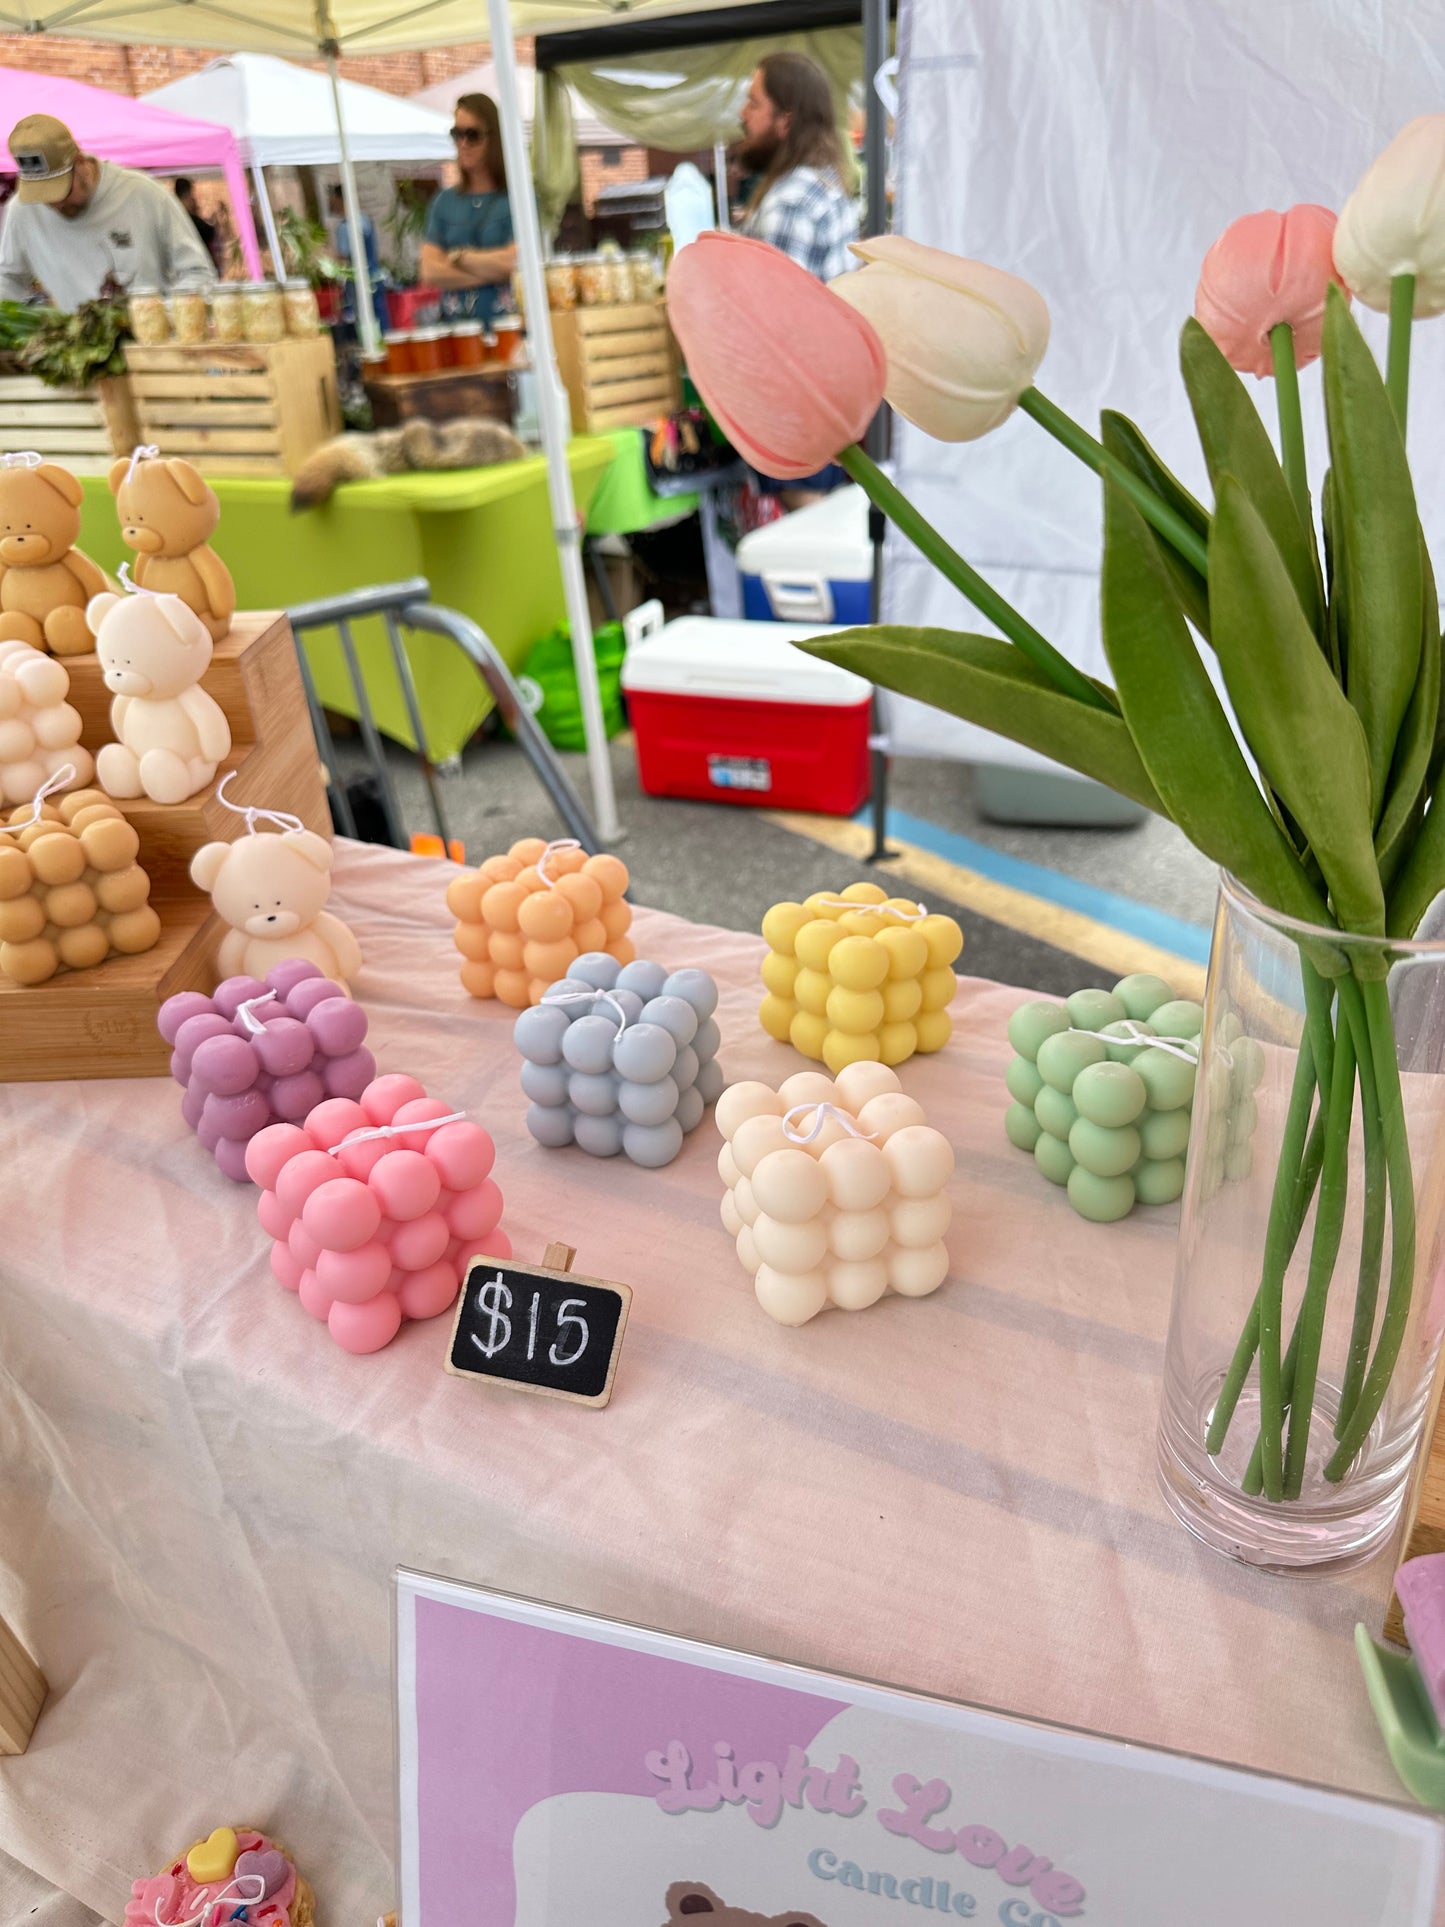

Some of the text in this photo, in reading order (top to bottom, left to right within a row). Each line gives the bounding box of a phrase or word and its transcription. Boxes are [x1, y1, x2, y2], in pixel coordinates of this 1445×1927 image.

[471, 1272, 589, 1365] $15
[645, 1739, 1086, 1917] Light Love
[807, 1847, 977, 1918] Candle
